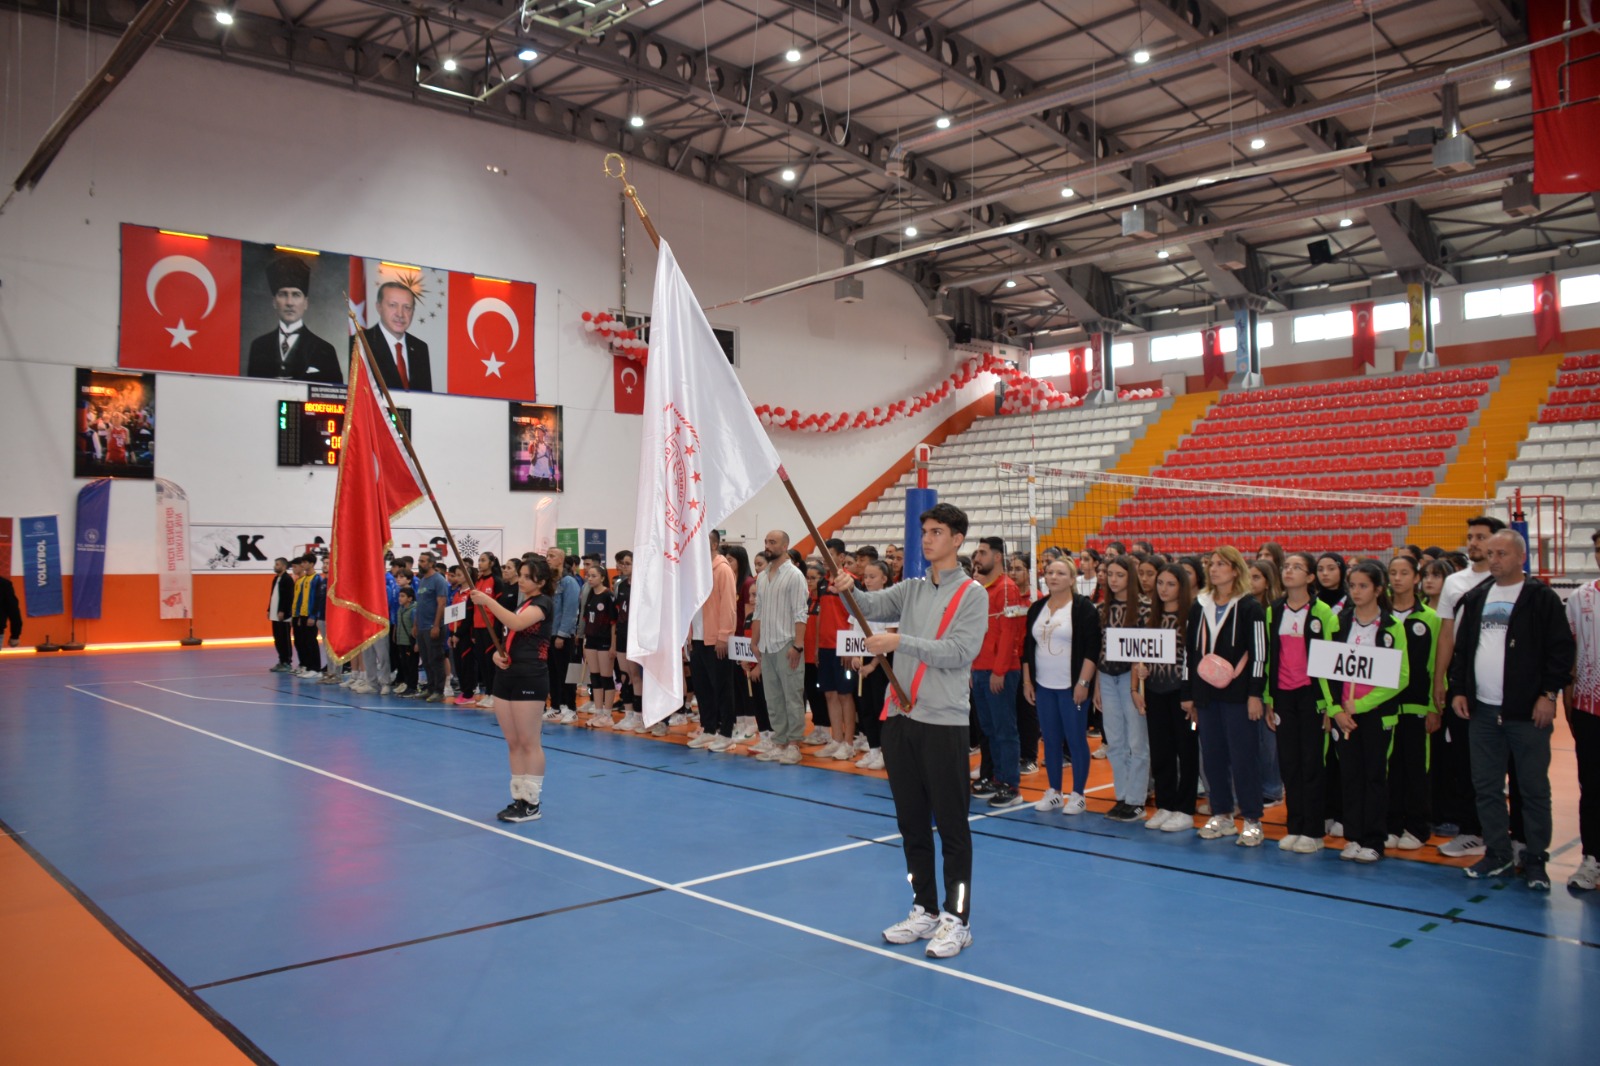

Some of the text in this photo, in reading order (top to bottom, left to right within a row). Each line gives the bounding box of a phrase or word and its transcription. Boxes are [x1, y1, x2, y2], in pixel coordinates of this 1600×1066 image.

[37, 540, 47, 587] VOLEYBOL
[1484, 621, 1508, 631] Colum
[1119, 634, 1163, 658] TUNCELİ
[1333, 649, 1374, 679] AĞRI
